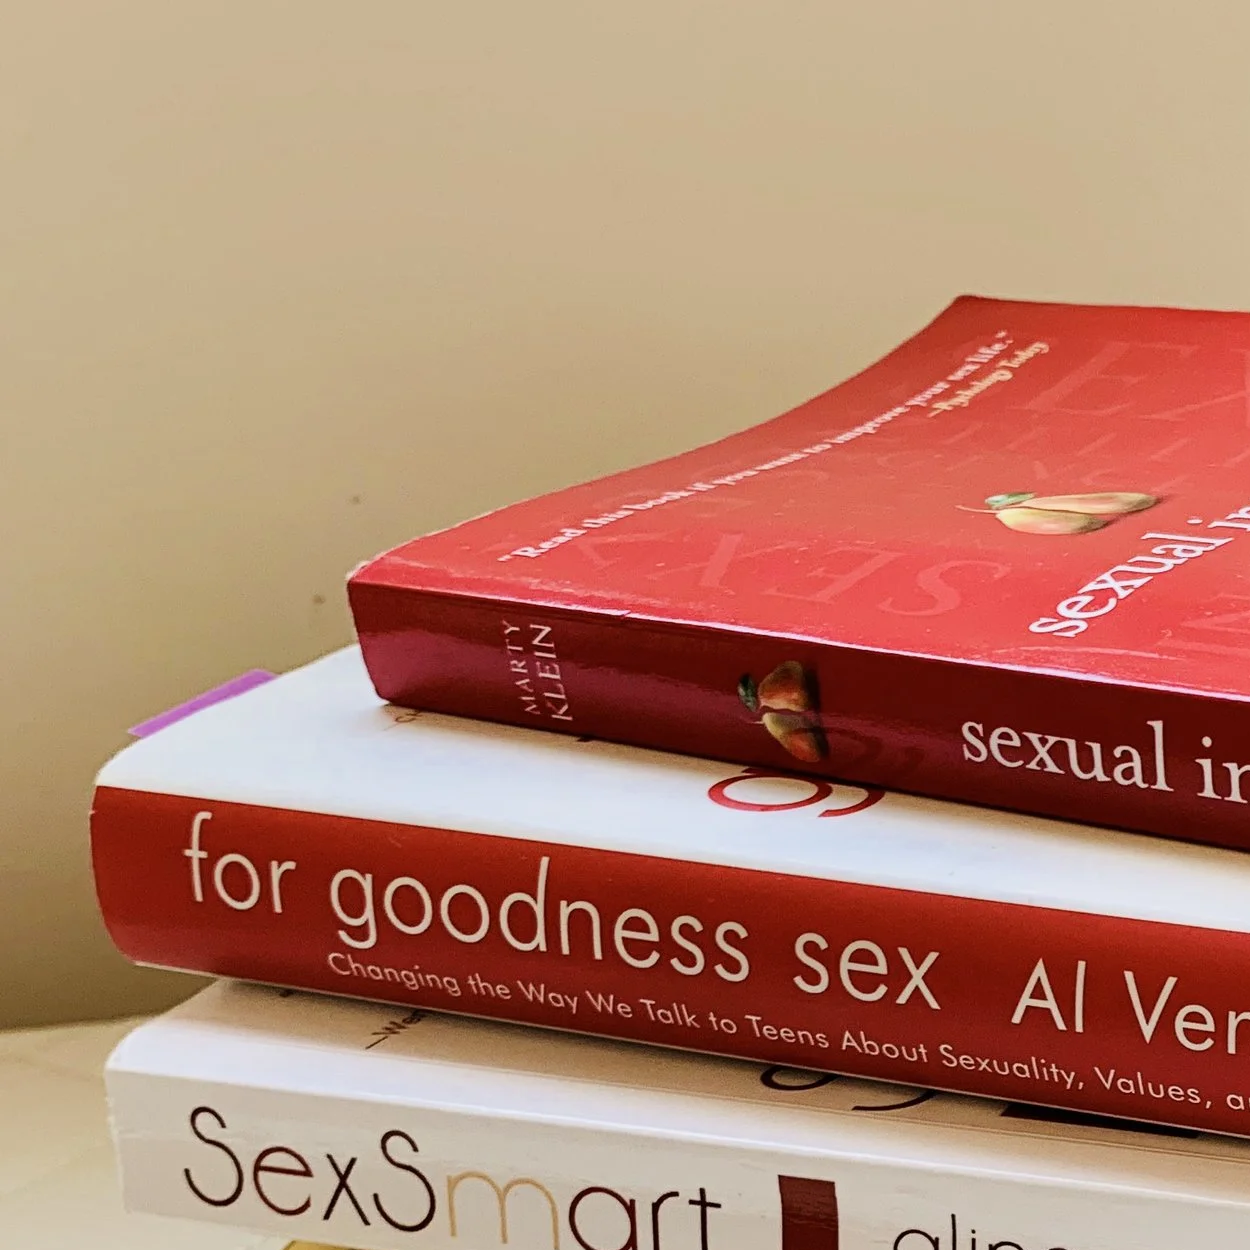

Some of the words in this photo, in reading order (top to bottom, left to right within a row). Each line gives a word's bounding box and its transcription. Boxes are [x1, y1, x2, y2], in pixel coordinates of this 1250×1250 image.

[582, 509, 635, 530] this
[620, 488, 696, 511] book
[1028, 531, 1226, 639] sexual
[503, 620, 540, 715] MARTY
[530, 623, 574, 721] KLEIN
[960, 719, 1174, 793] sexual
[184, 811, 296, 914] for
[330, 855, 751, 984] goodness
[793, 931, 942, 1010] sex
[1011, 957, 1087, 1034] Al
[327, 952, 462, 997] Changing
[467, 973, 512, 1001] the
[516, 980, 578, 1014] Way
[586, 990, 633, 1018] We
[639, 999, 700, 1029] Talk
[708, 1011, 738, 1034] to
[744, 1014, 829, 1049] Teens
[841, 1030, 928, 1064] About
[938, 1043, 1085, 1091] Sexuality,
[1094, 1066, 1213, 1110] Values,
